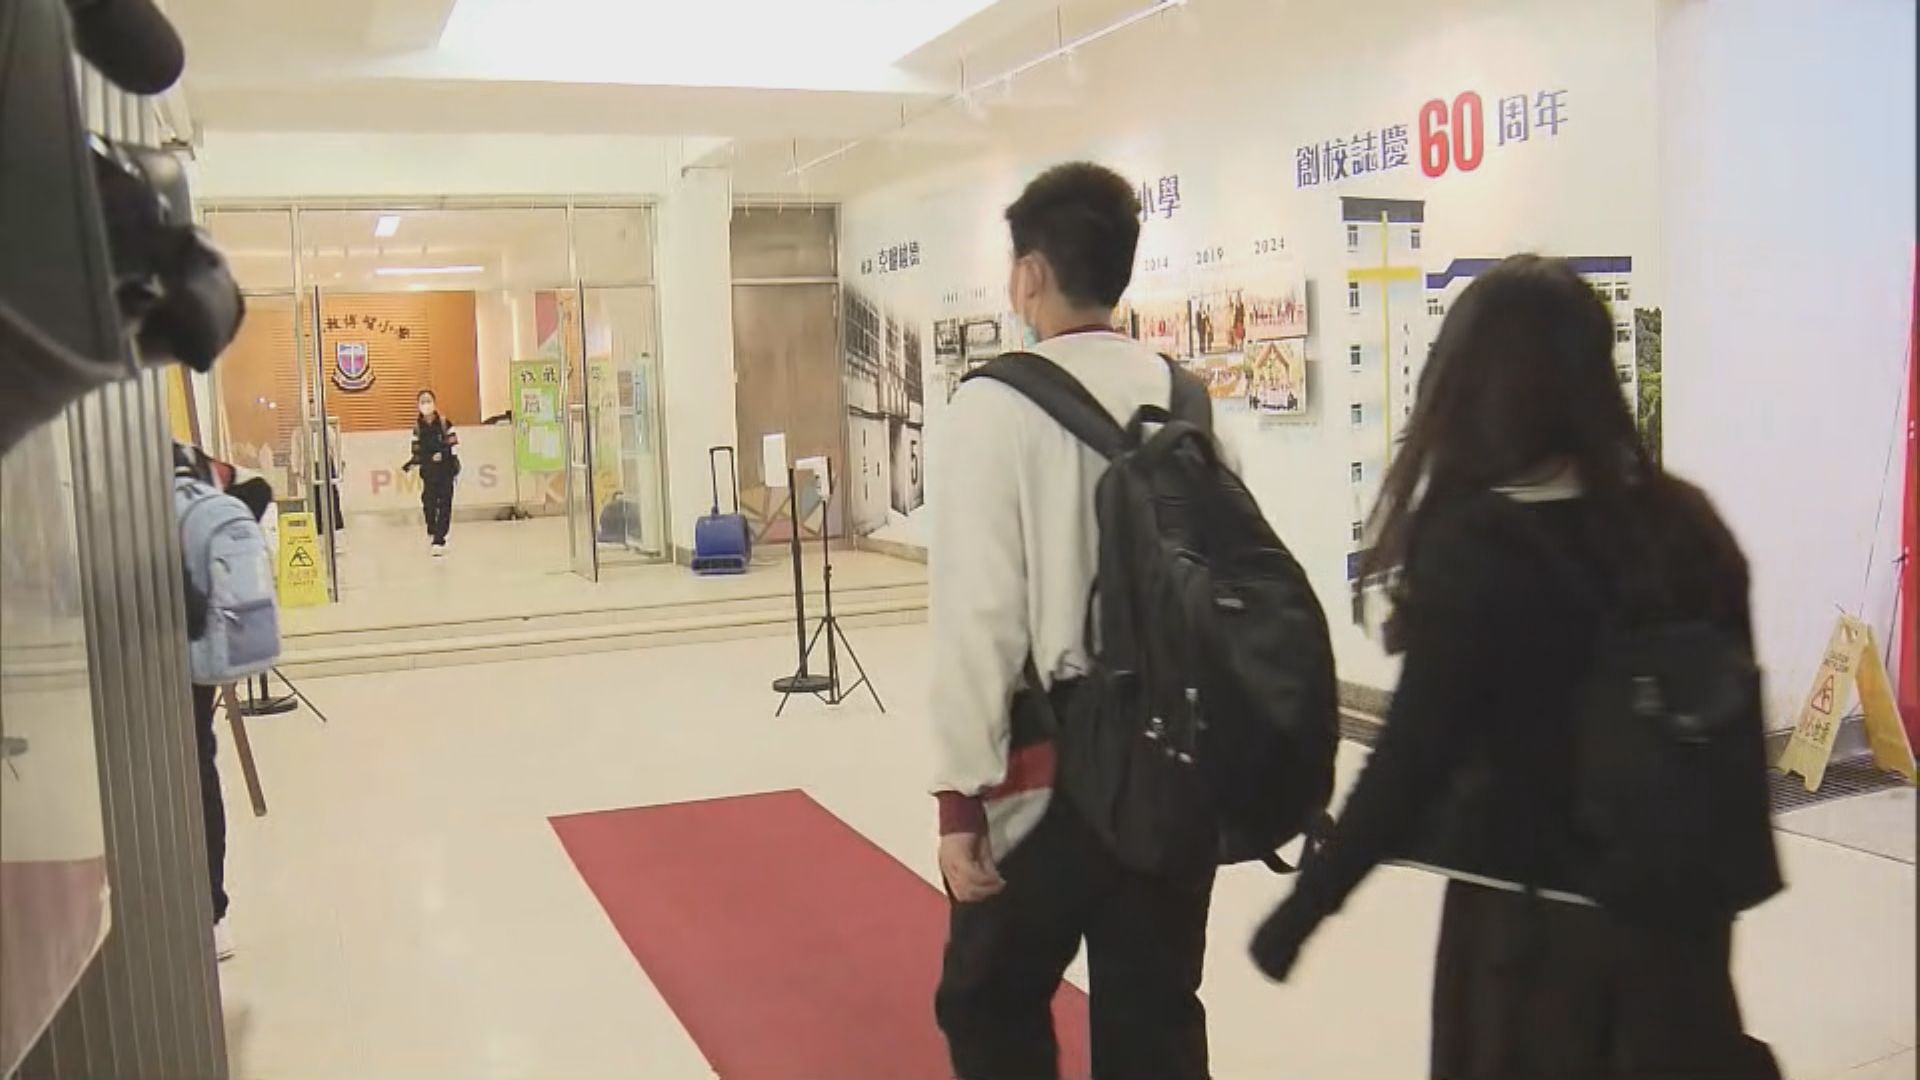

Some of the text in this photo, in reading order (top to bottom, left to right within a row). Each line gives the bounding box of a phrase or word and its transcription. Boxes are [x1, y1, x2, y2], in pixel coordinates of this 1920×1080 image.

[1297, 90, 1568, 187] 創校誌慶 60 周年
[1254, 237, 1285, 255] 2024
[1196, 247, 1224, 265] 2019
